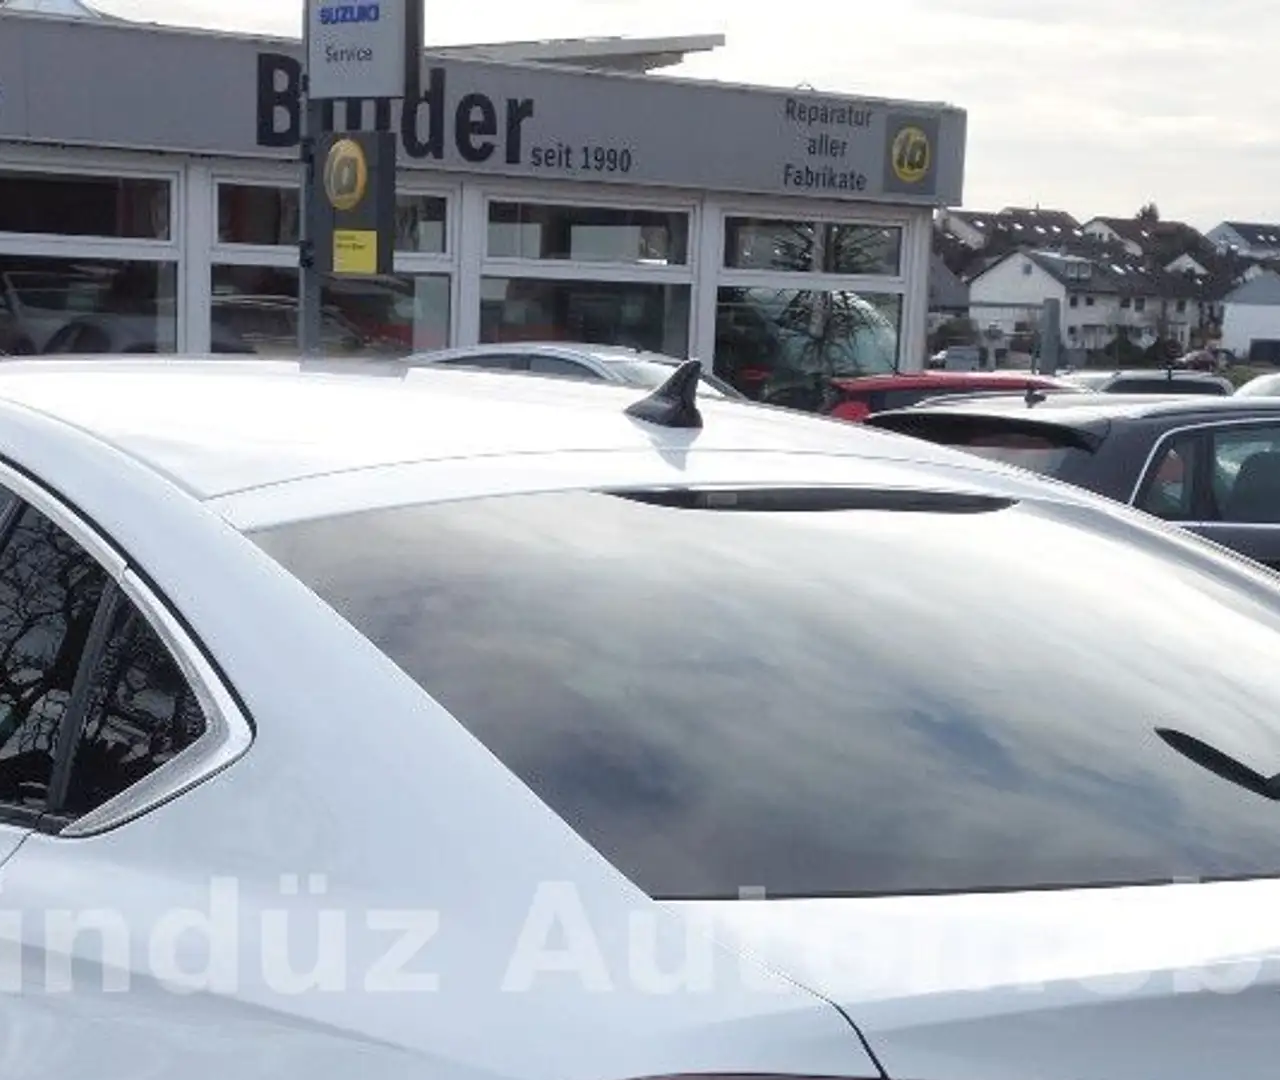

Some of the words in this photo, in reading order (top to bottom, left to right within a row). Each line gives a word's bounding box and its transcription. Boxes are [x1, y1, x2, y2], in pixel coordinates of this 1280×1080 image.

[325, 46, 372, 63] Service
[785, 98, 872, 127] Reparatur
[531, 144, 570, 169] seit
[580, 146, 632, 172] 1990
[808, 133, 848, 157] aller
[783, 163, 868, 191] Fabrikate
